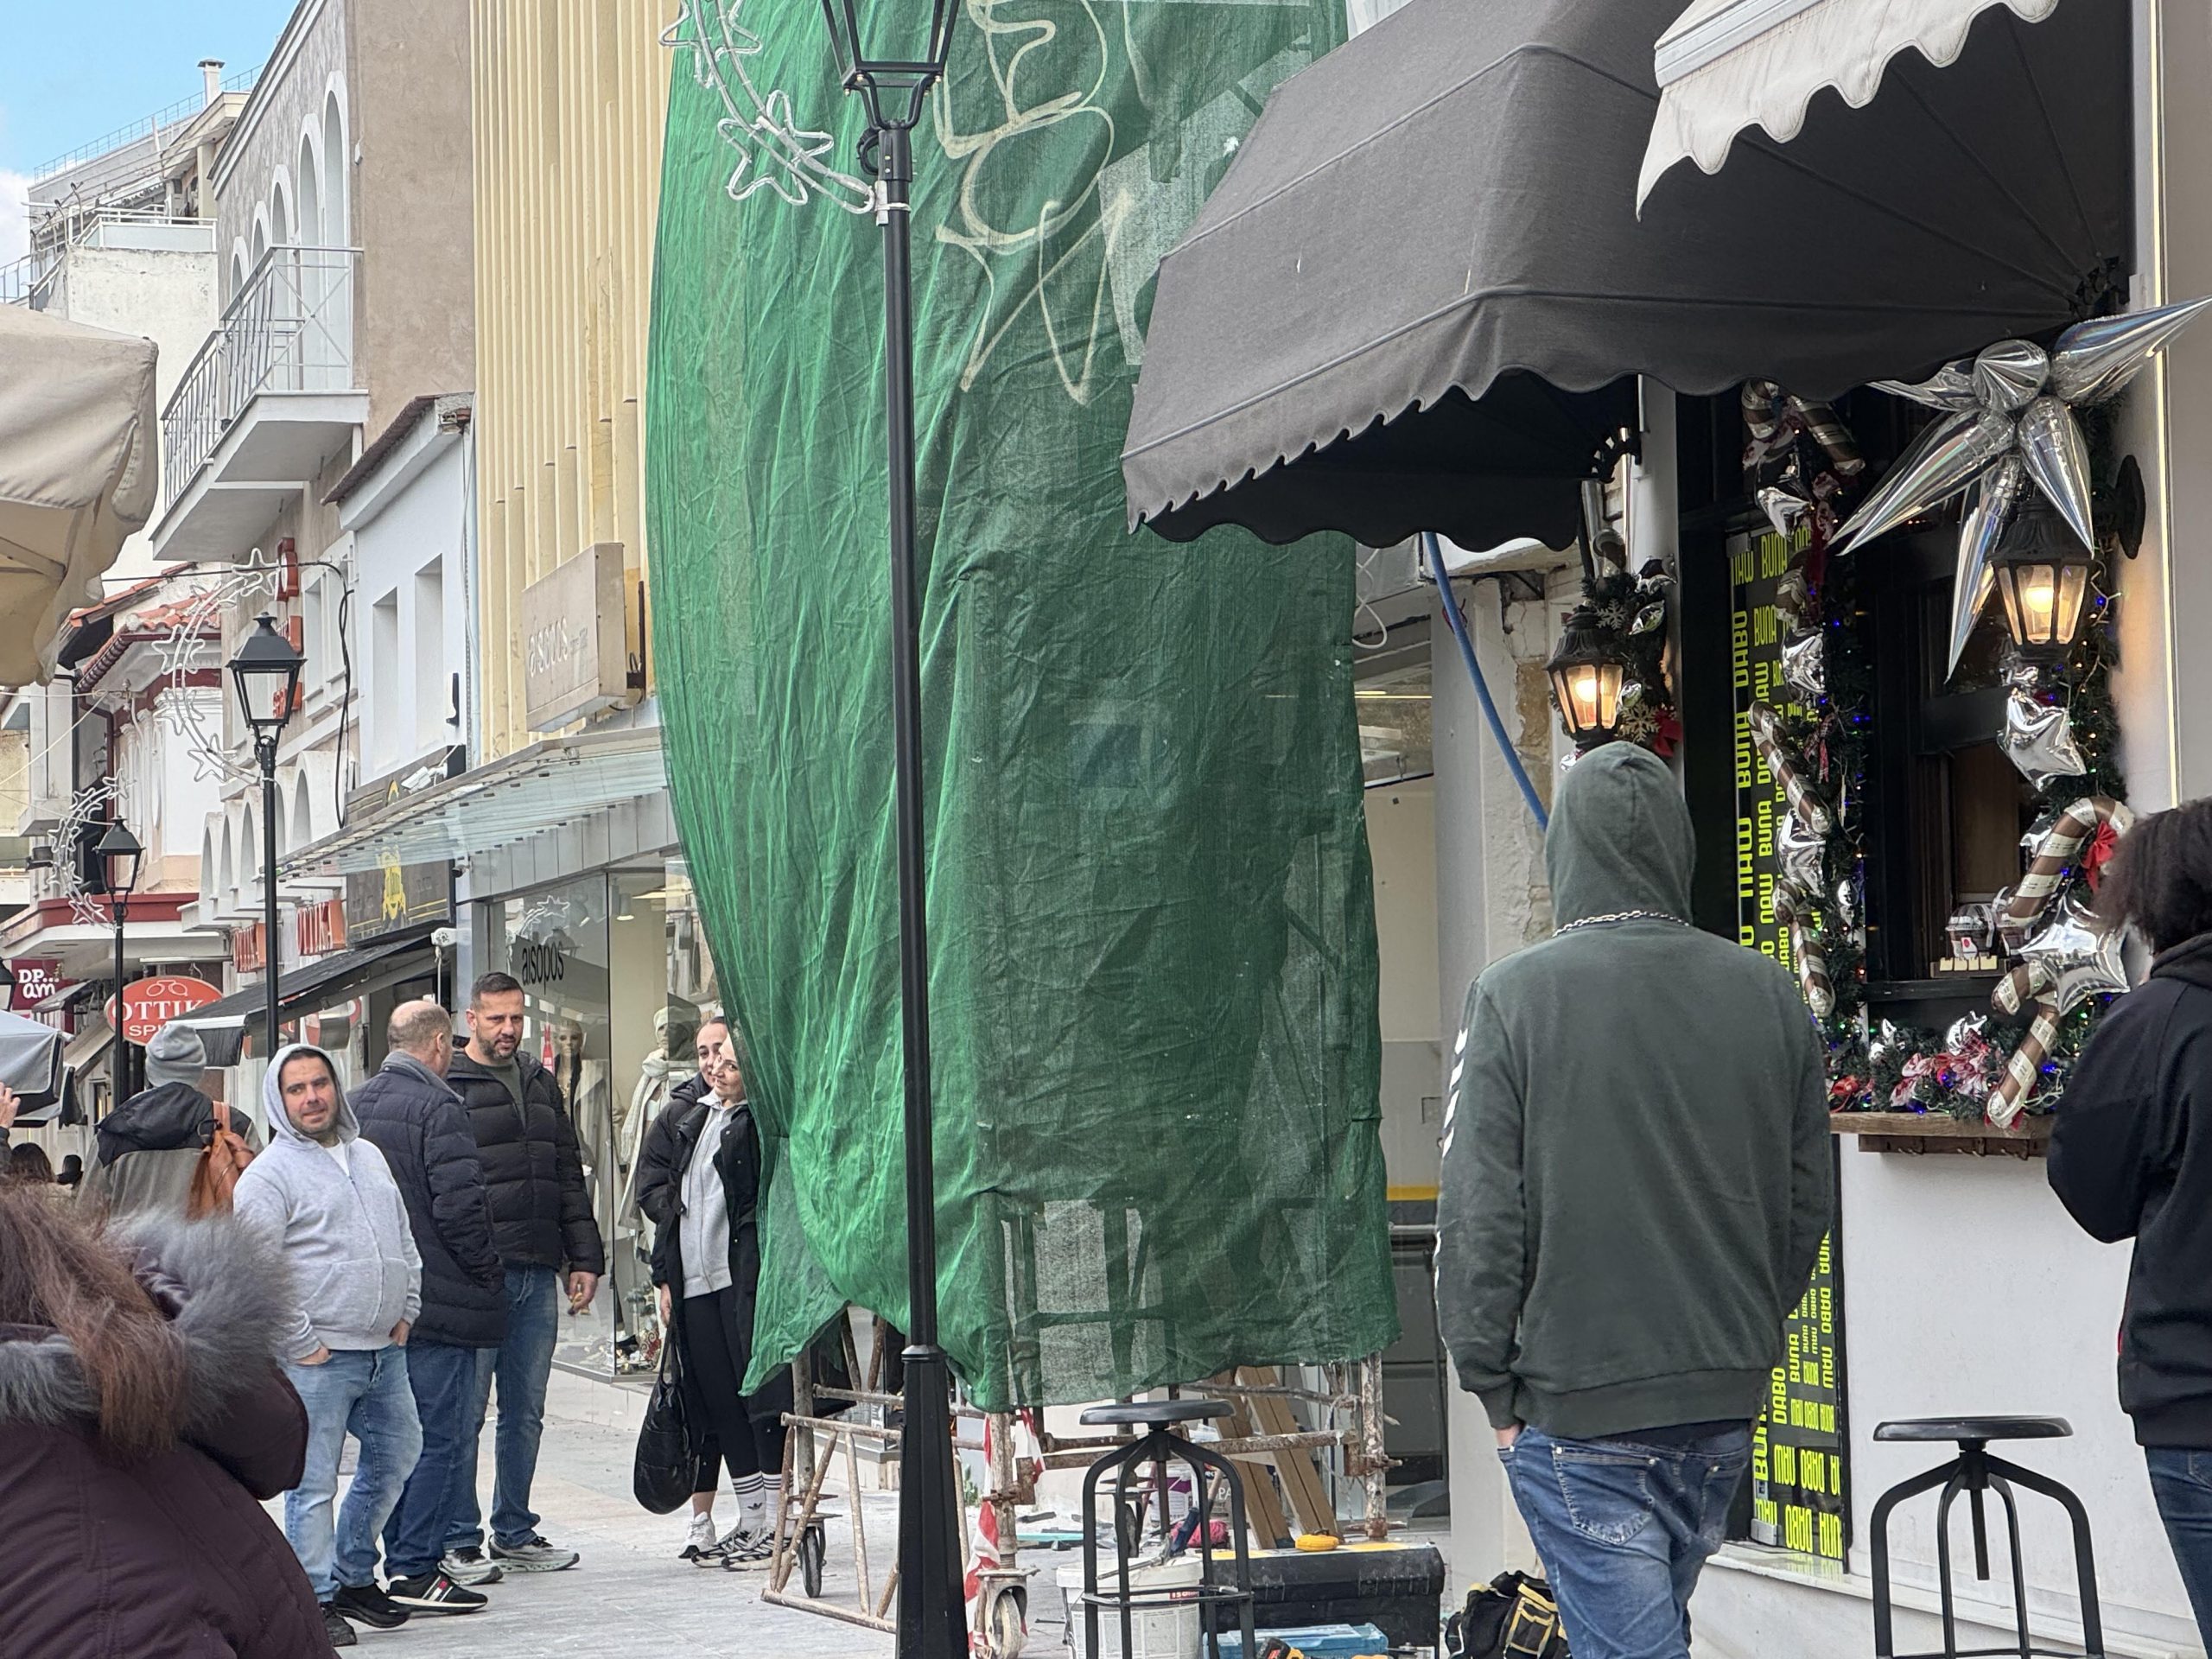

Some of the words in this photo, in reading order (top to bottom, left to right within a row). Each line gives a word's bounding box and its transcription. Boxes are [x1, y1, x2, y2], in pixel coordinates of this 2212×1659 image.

[1758, 800, 1773, 857] BUNA
[112, 1000, 205, 1021] OTTIK
[1821, 1287, 1832, 1334] DABO
[1789, 1333, 1800, 1382] BUNA
[1821, 1346, 1834, 1389] NAW
[1771, 1367, 1787, 1424] DABO
[1774, 1444, 1796, 1486] NAW
[1800, 1449, 1825, 1493] DABO
[1785, 1504, 1814, 1554] DABO
